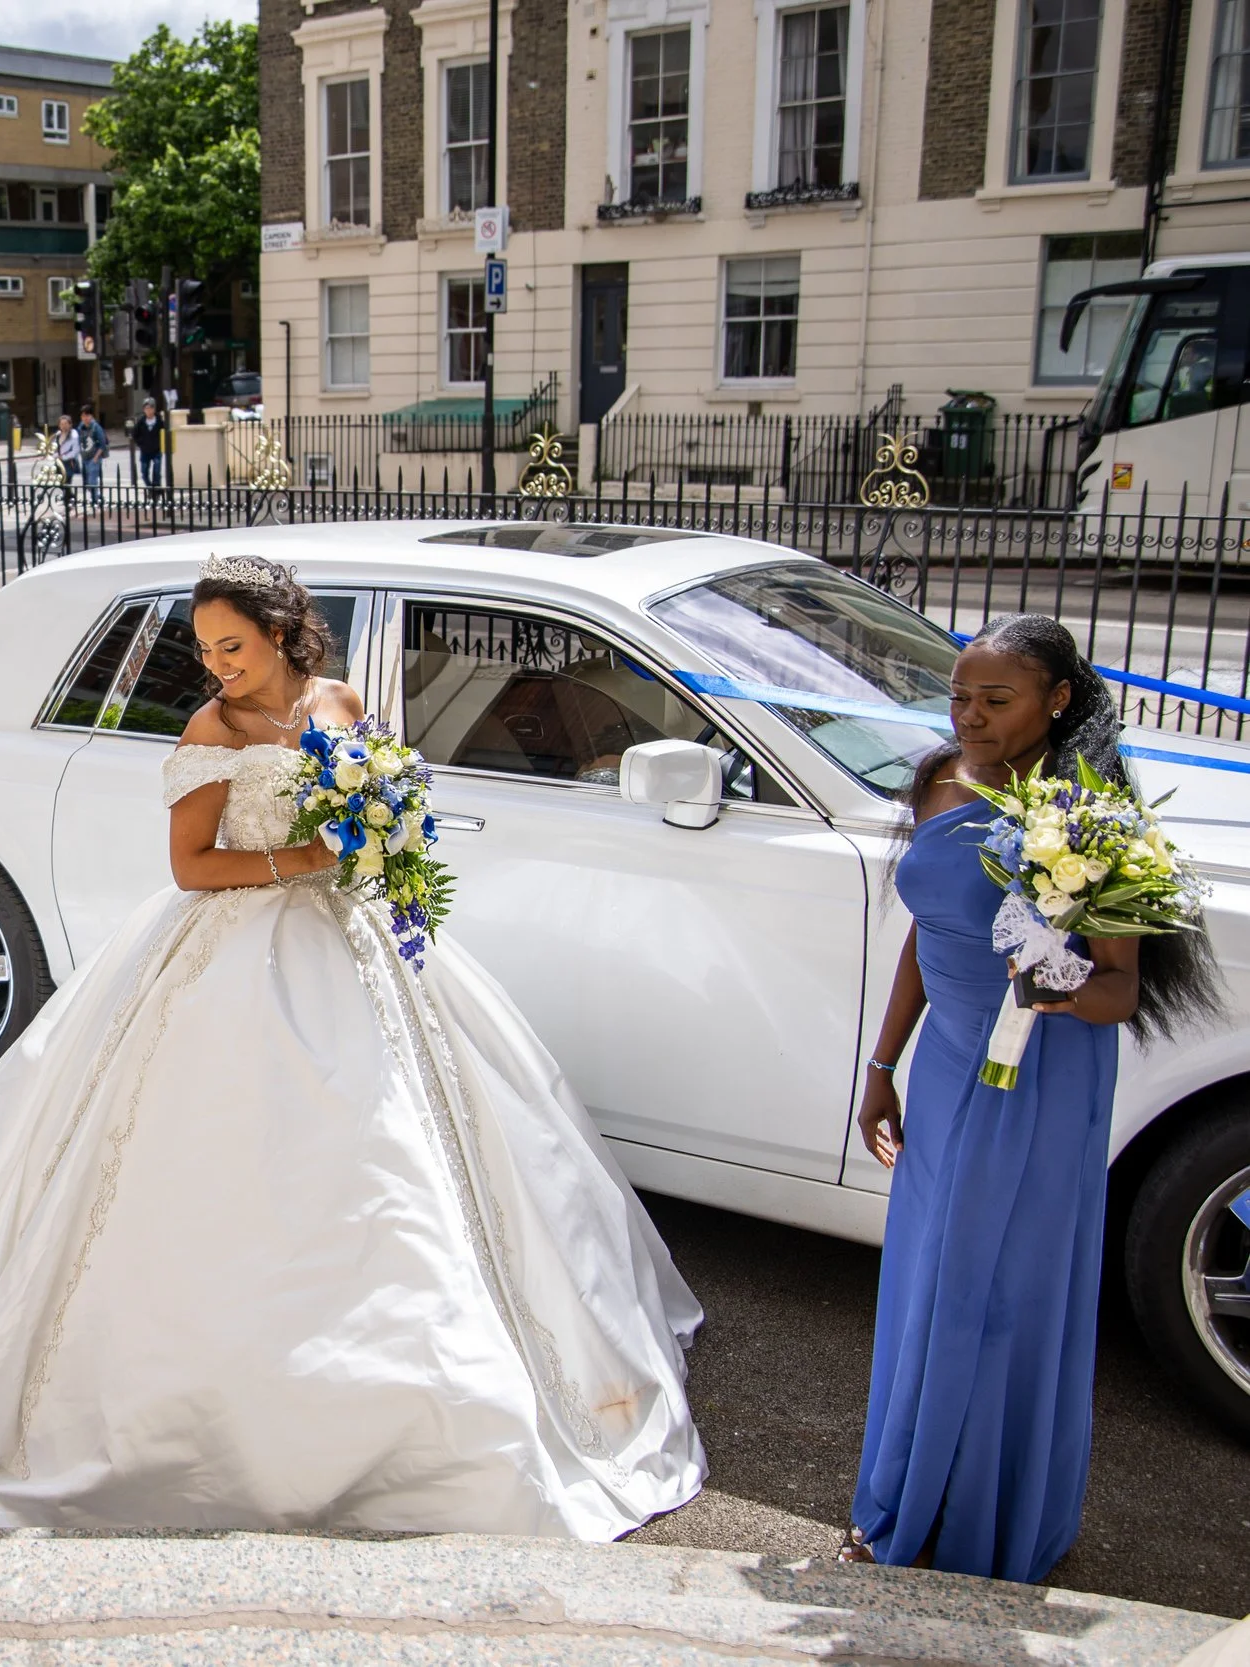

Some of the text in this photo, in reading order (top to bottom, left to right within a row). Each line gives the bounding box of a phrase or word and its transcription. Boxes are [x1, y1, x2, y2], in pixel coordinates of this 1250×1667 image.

[264, 232, 291, 240] CAMDEN
[264, 240, 287, 249] STREET
[492, 267, 502, 292] P
